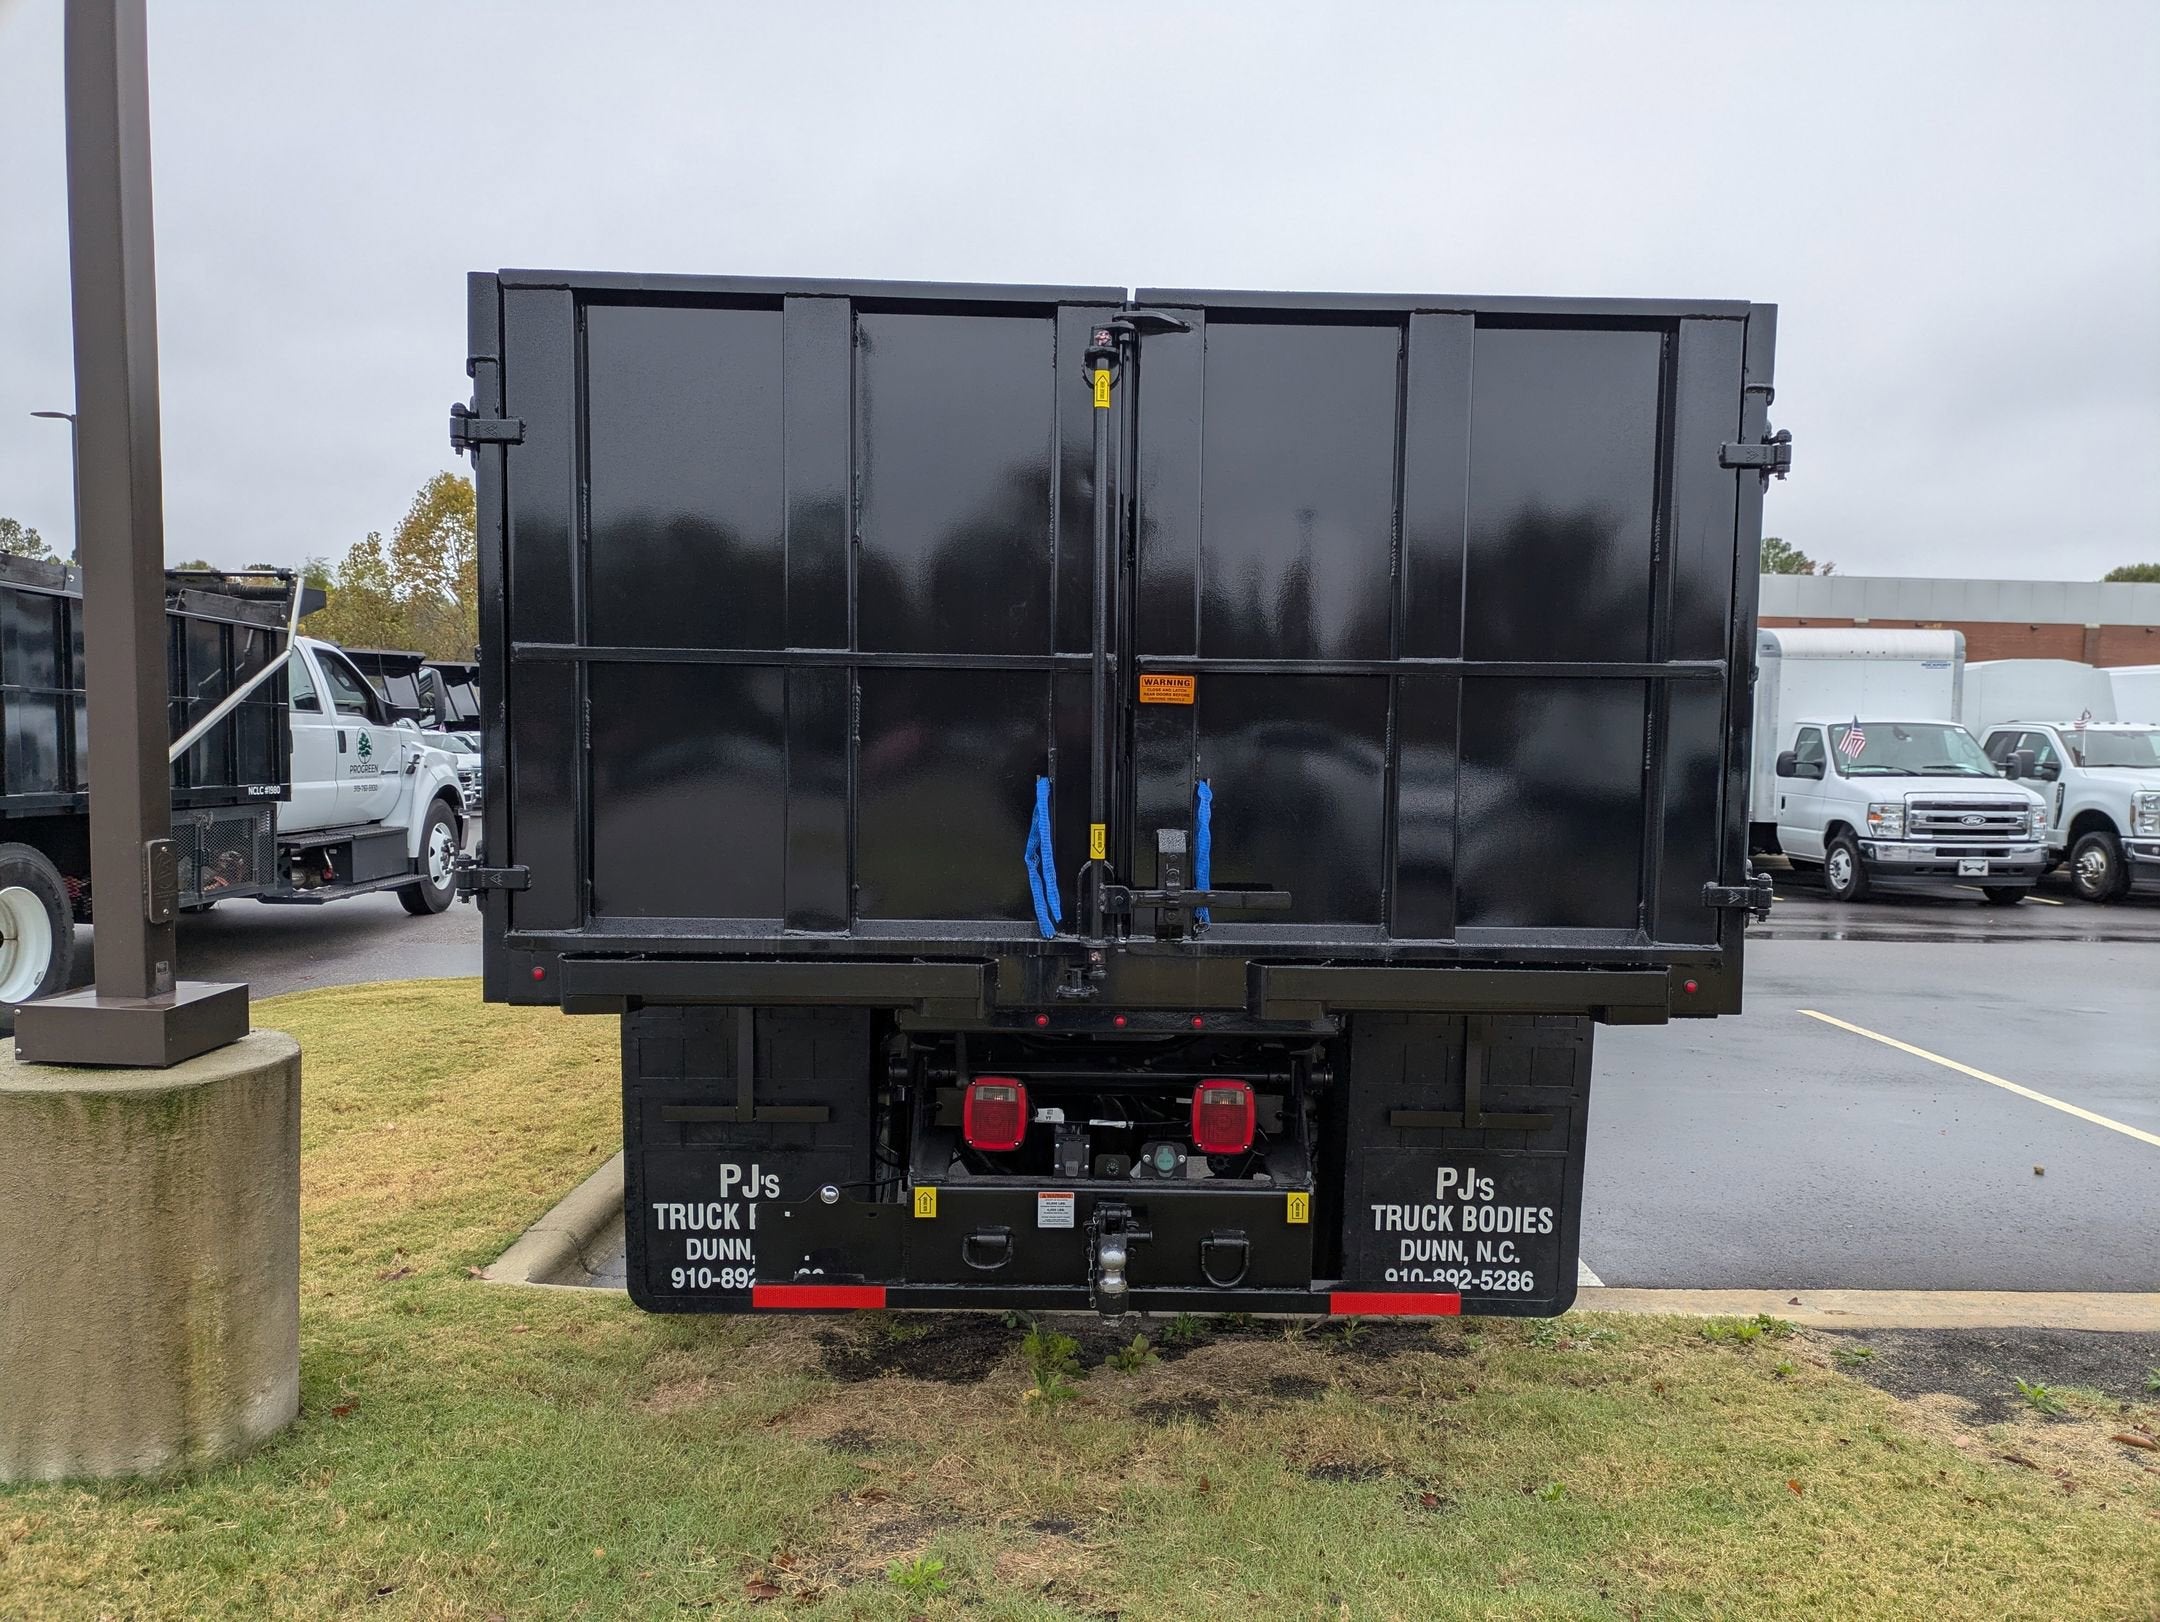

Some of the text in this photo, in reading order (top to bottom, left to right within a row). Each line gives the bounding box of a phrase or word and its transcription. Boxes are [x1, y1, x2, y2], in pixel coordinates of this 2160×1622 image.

[1143, 678, 1191, 687] WARNING
[349, 764, 379, 774] PROGREEN
[248, 786, 264, 796] NCLC
[720, 1163, 780, 1199] PJ's
[1436, 1166, 1495, 1201] PJ's
[652, 1203, 740, 1230] TRUCK
[1370, 1204, 1554, 1234] TRUCK BODIES
[1400, 1239, 1521, 1266] DUNN, N.C.
[1385, 1268, 1534, 1292] 910-892-5286
